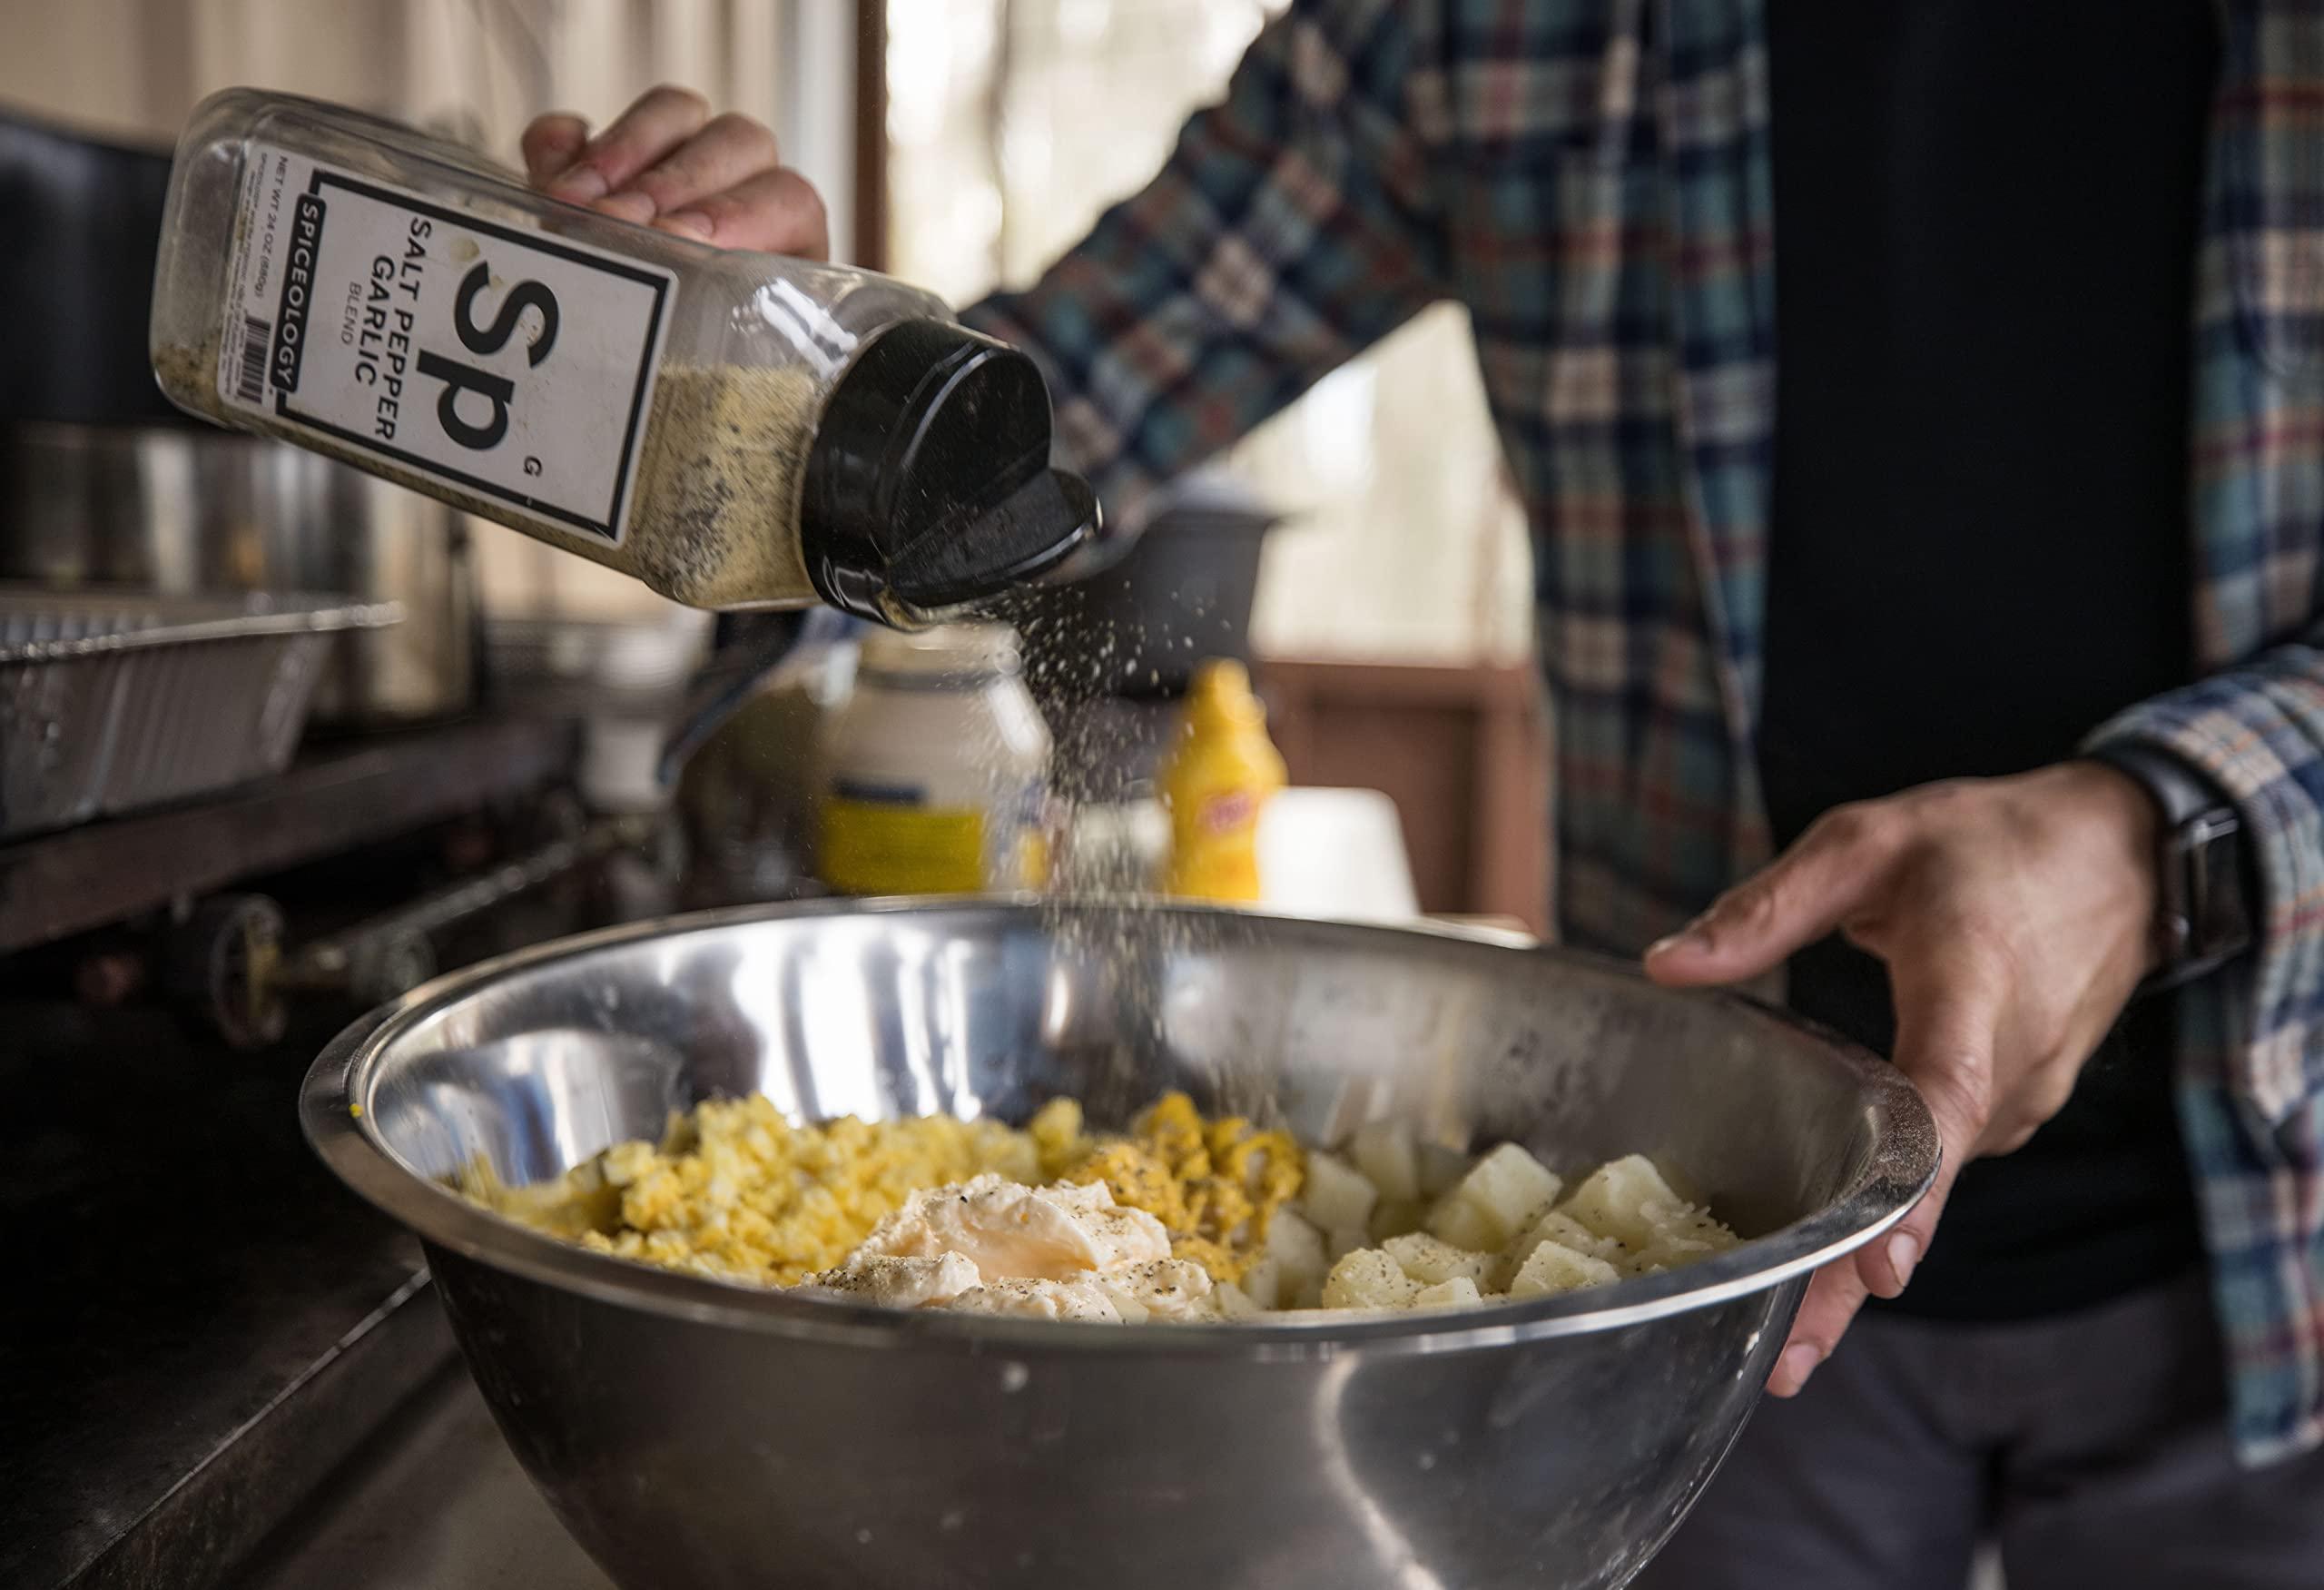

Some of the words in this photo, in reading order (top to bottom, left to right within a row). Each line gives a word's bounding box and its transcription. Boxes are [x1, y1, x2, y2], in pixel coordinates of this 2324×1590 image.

[271, 188, 282, 212] WT
[276, 155, 288, 185] NET
[262, 232, 274, 254] OZ
[267, 212, 277, 231] 24
[399, 216, 433, 301] SALT
[277, 202, 319, 385] SPICEOLOGY
[341, 282, 362, 345] BLEND
[355, 253, 396, 386] GARLIC
[374, 311, 415, 440] PEPPER
[416, 262, 559, 450] Sp
[523, 456, 543, 478] G
